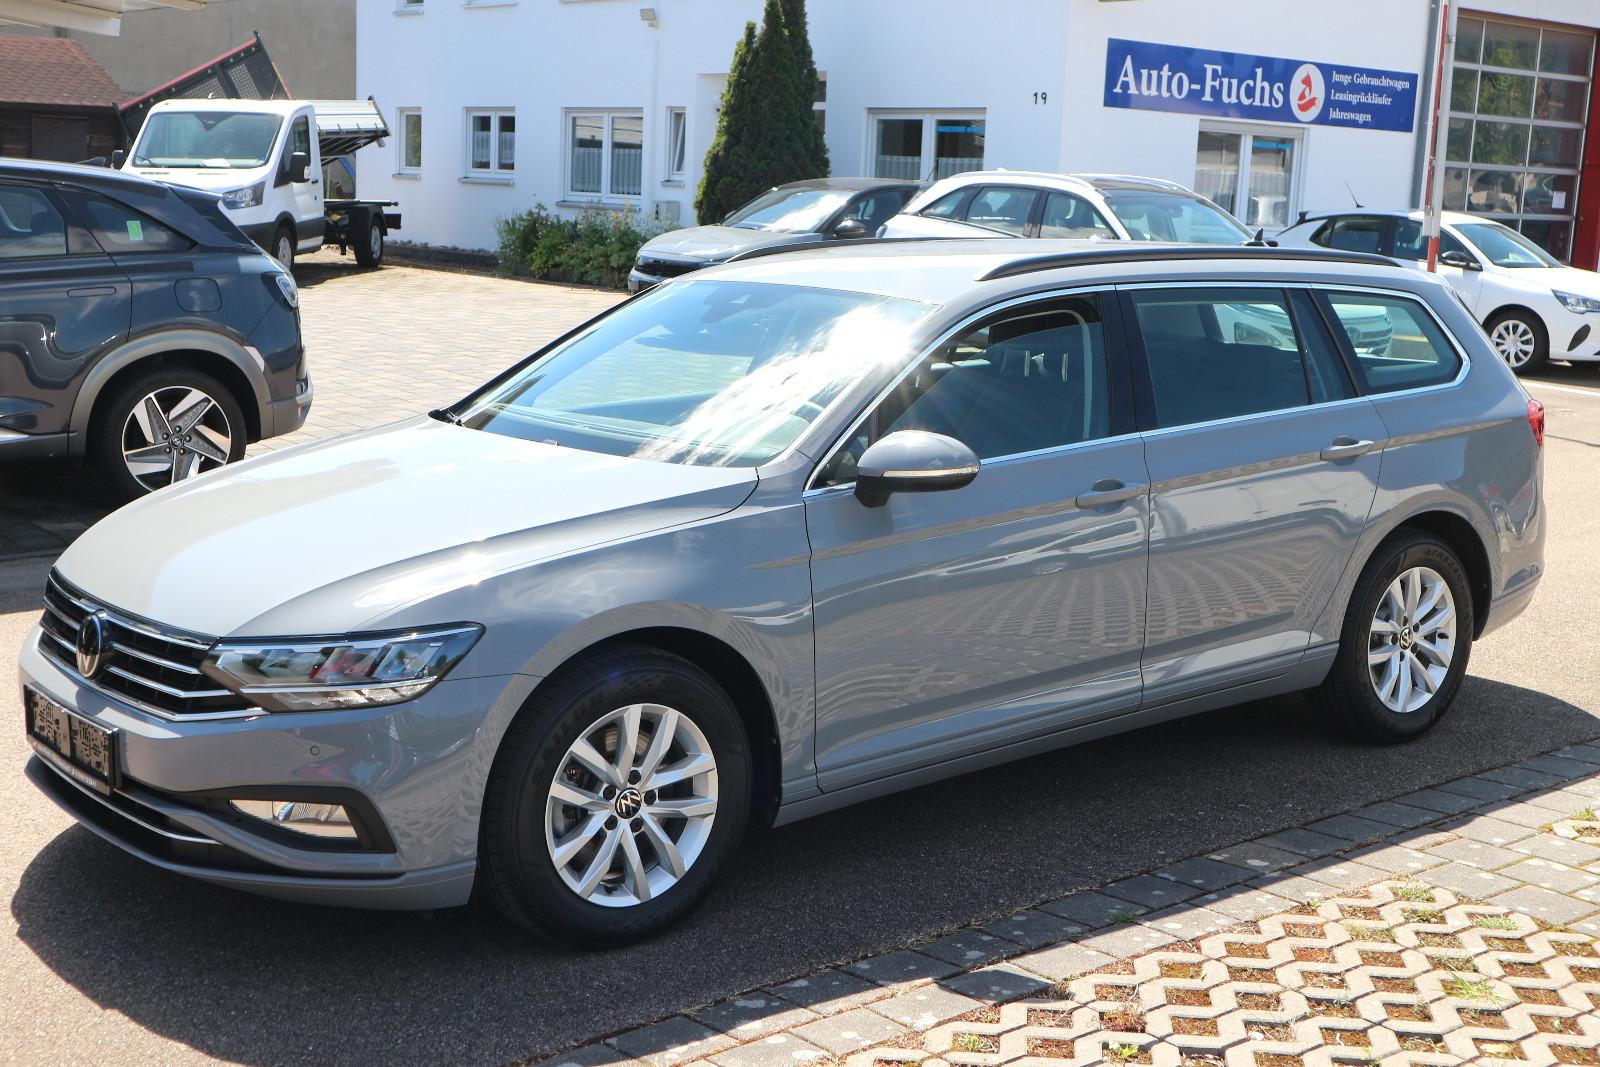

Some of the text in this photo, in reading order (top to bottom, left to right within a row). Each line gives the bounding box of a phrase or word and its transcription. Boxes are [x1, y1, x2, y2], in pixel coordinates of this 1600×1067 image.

[1113, 54, 1284, 109] Auto-Fuchs
[1331, 70, 1410, 91] Junge Gebrauchtwagen
[1033, 91, 1048, 105] 19
[1330, 89, 1393, 105] Leasingrückläufer
[1328, 107, 1372, 124] Jahreswagen
